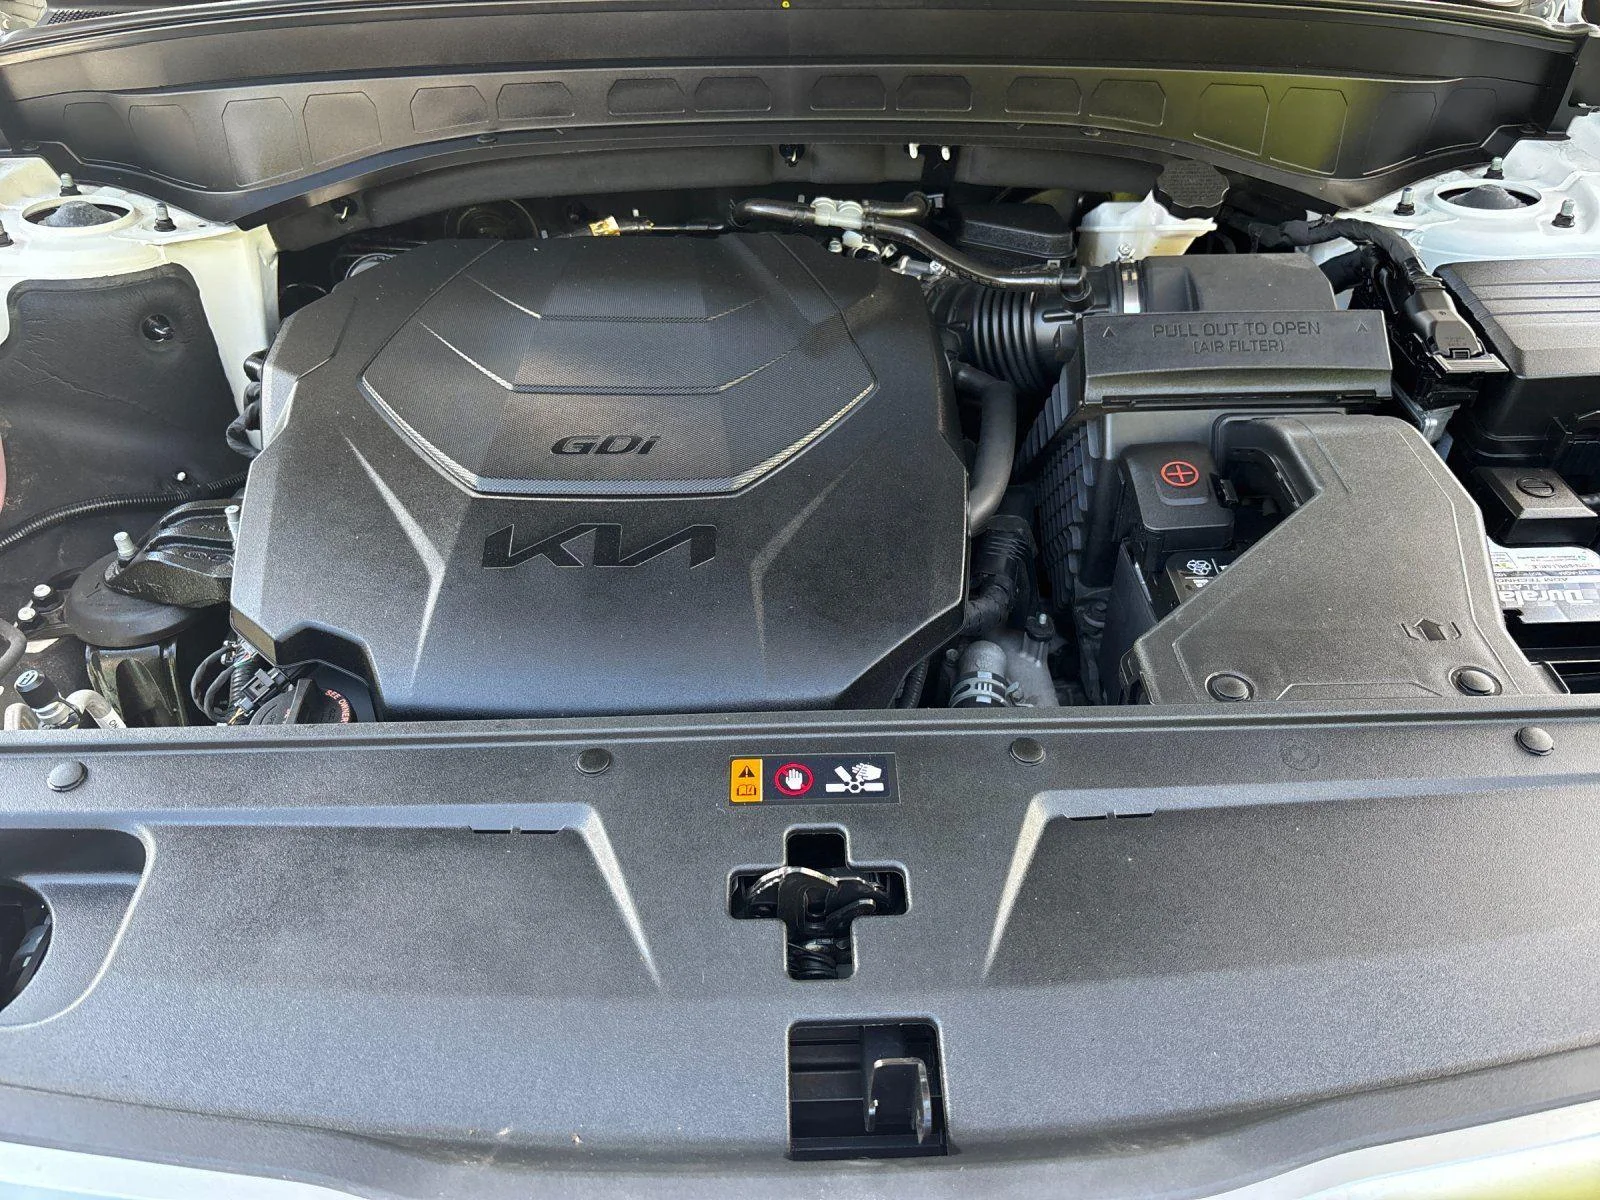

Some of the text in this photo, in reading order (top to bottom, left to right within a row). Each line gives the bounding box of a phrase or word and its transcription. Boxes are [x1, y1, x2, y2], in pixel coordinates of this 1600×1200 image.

[1152, 321, 1321, 339] PULL OUT TO OPEN
[550, 435, 661, 455] GDi
[325, 689, 341, 700] SEE
